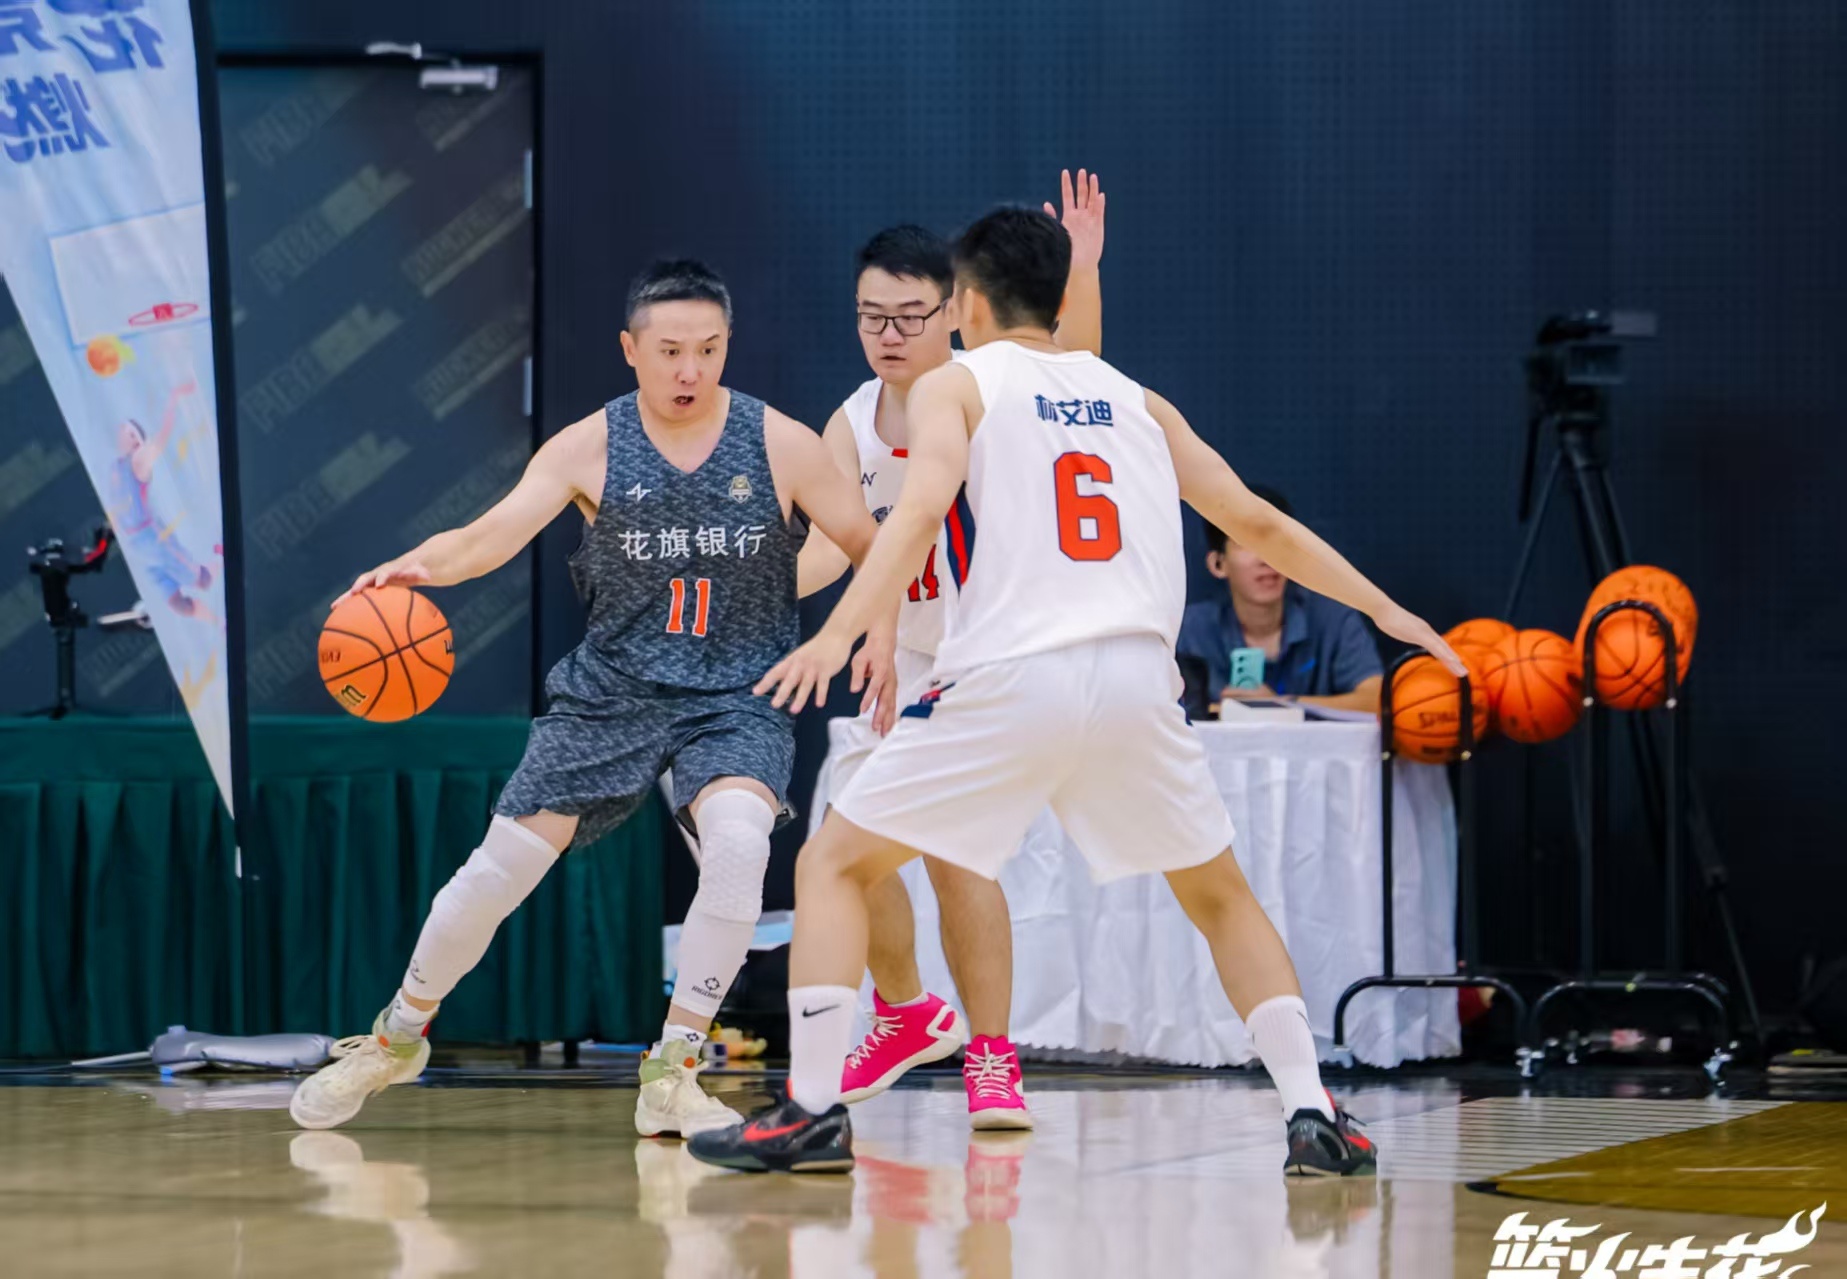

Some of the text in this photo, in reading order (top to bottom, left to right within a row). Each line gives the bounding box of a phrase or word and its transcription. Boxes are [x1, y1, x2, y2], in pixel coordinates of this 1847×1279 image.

[1054, 451, 1122, 561] 6
[618, 525, 767, 560] 花旗银行
[666, 578, 711, 637] 11
